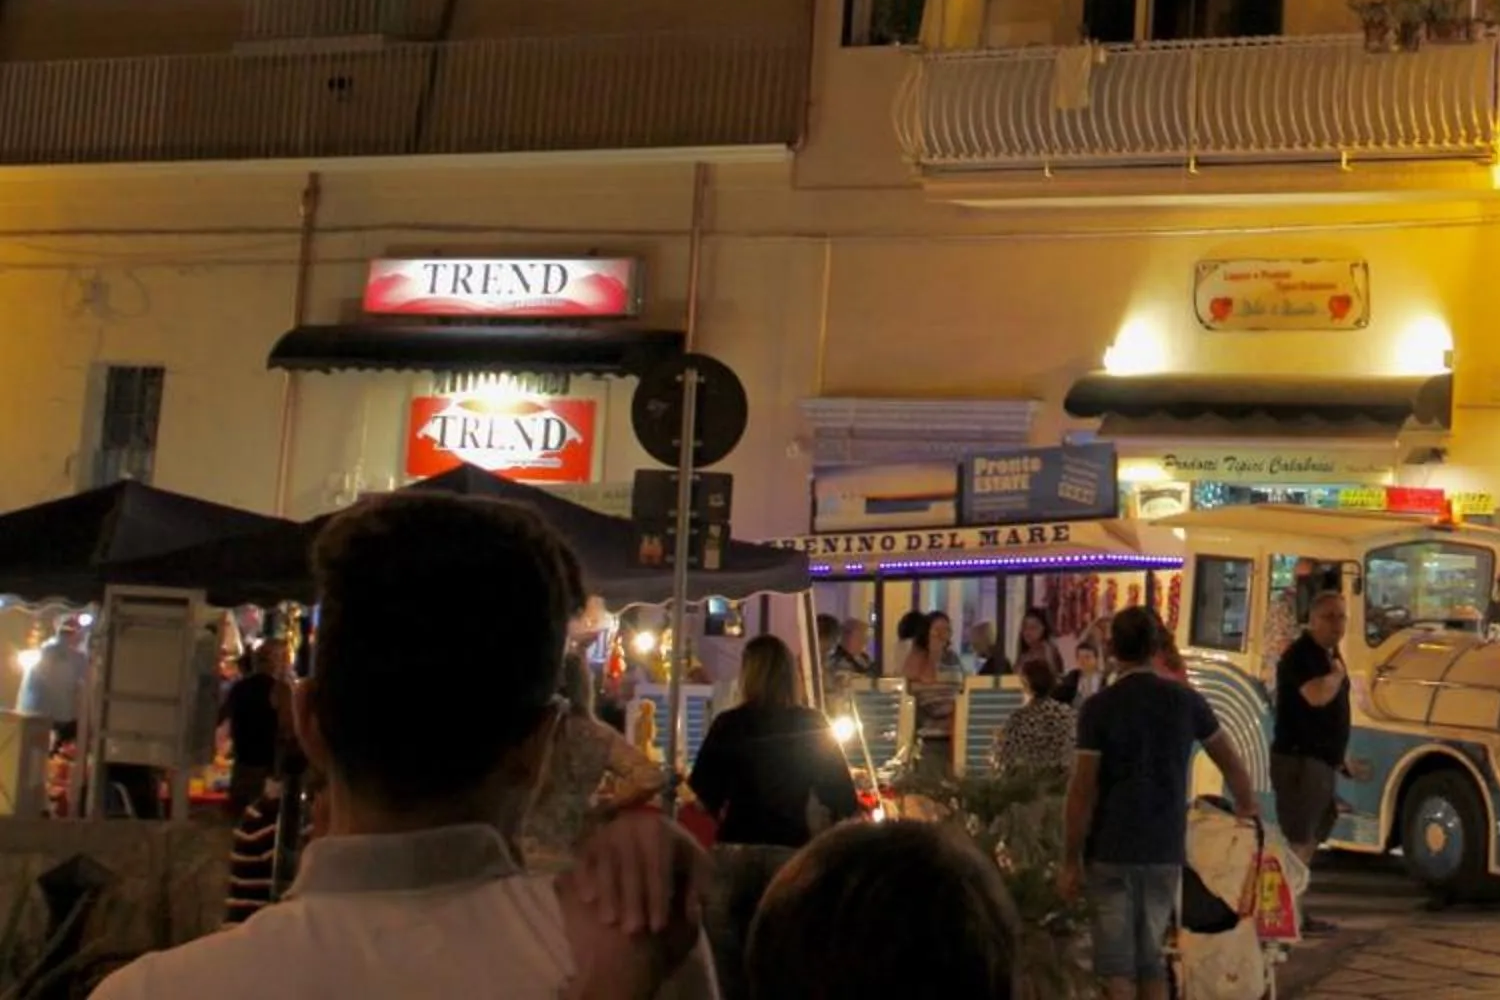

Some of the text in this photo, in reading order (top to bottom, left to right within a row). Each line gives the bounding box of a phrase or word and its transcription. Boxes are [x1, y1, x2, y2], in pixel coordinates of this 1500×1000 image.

[423, 263, 569, 295] TREND
[432, 414, 568, 451] TREND
[974, 456, 1042, 475] Pronto
[1163, 453, 1219, 471] Prodotti
[1223, 455, 1265, 475] Tipici
[774, 524, 1071, 553] RENINO DEL MARE
